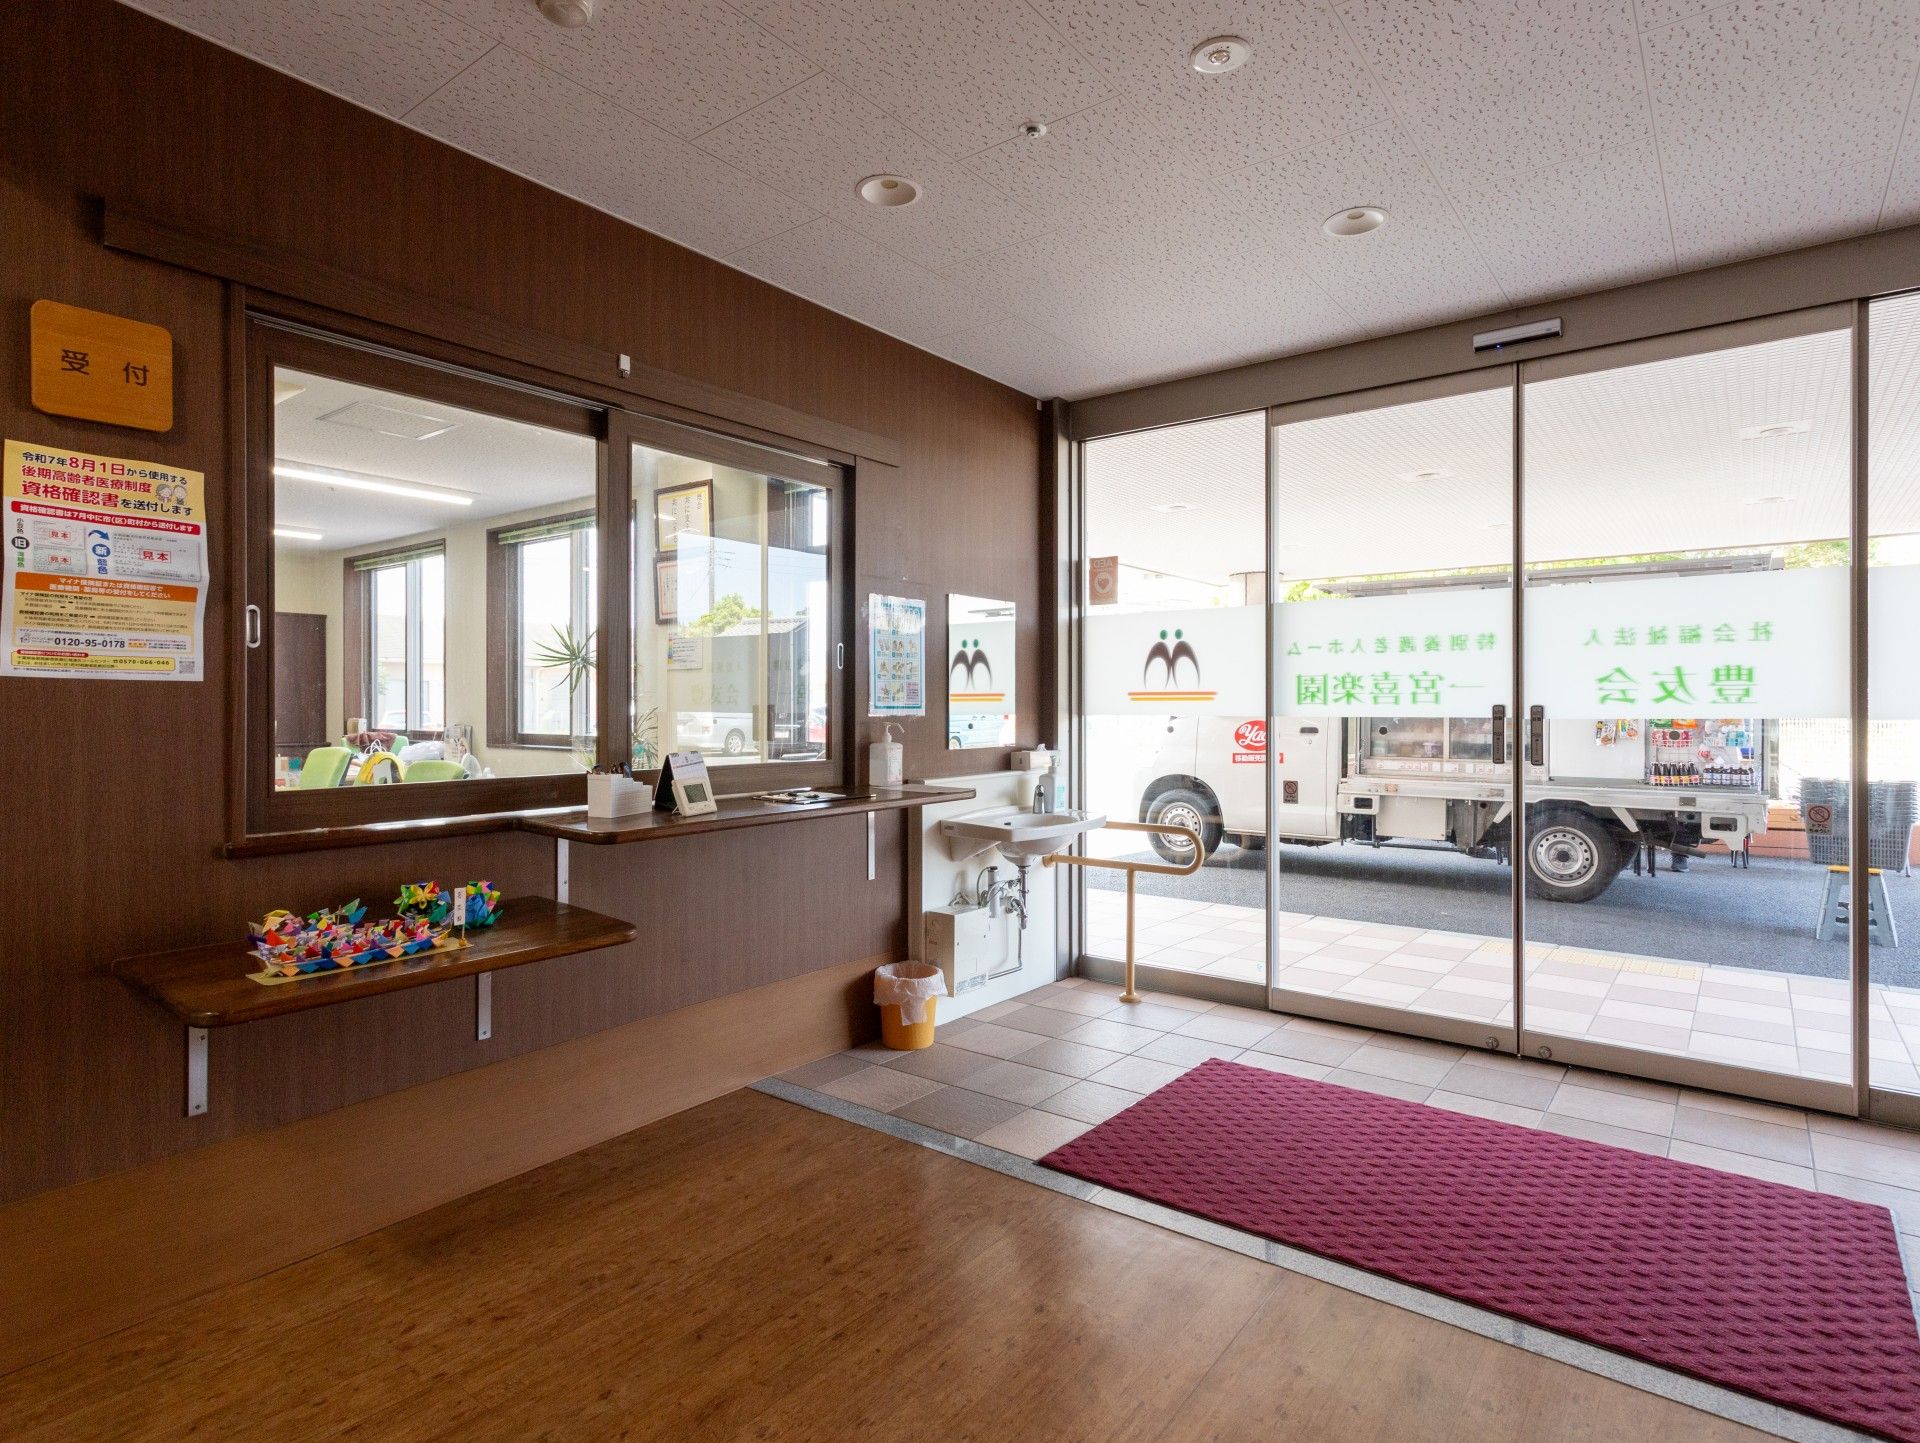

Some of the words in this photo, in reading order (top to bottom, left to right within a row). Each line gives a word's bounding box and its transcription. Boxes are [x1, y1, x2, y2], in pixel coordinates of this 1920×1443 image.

[22, 451, 188, 486] 令和7年8月1日から使用する
[22, 464, 152, 494] 後期高齢者医療制度
[22, 480, 193, 517] 資格確認書を送付します
[95, 545, 107, 556] 新
[143, 550, 169, 562] 見本
[54, 637, 126, 649] 0120-95-0178
